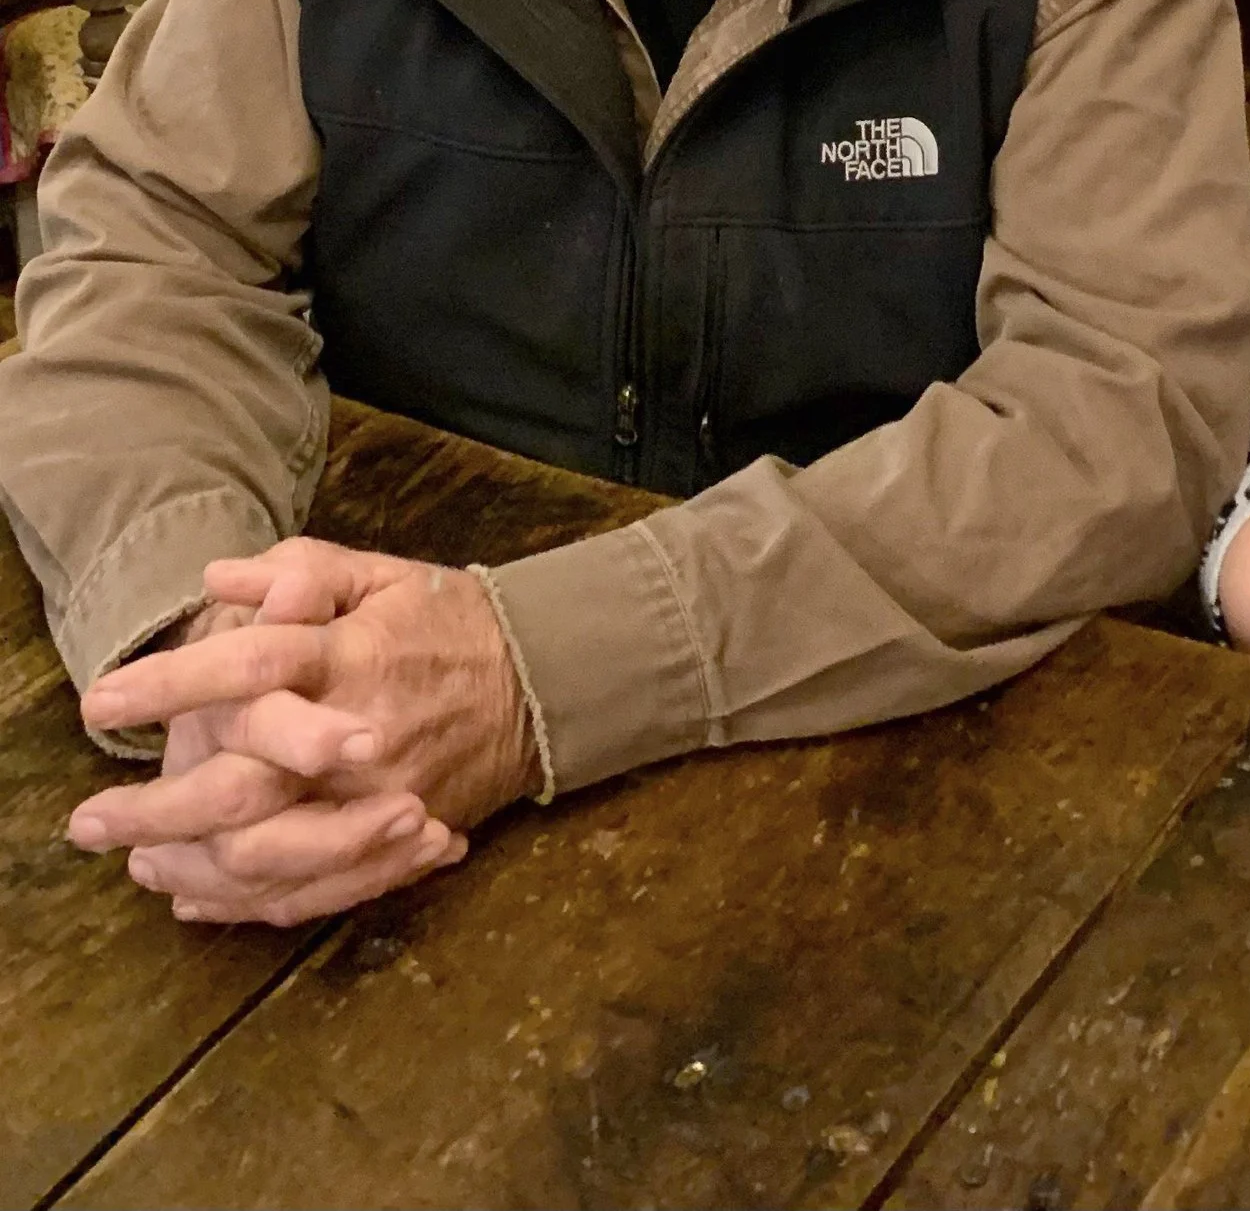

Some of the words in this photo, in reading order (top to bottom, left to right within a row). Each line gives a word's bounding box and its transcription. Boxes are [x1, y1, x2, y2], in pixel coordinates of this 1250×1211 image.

[855, 117, 901, 140] THE
[821, 138, 901, 163] NORTH
[845, 158, 902, 181] FACE
